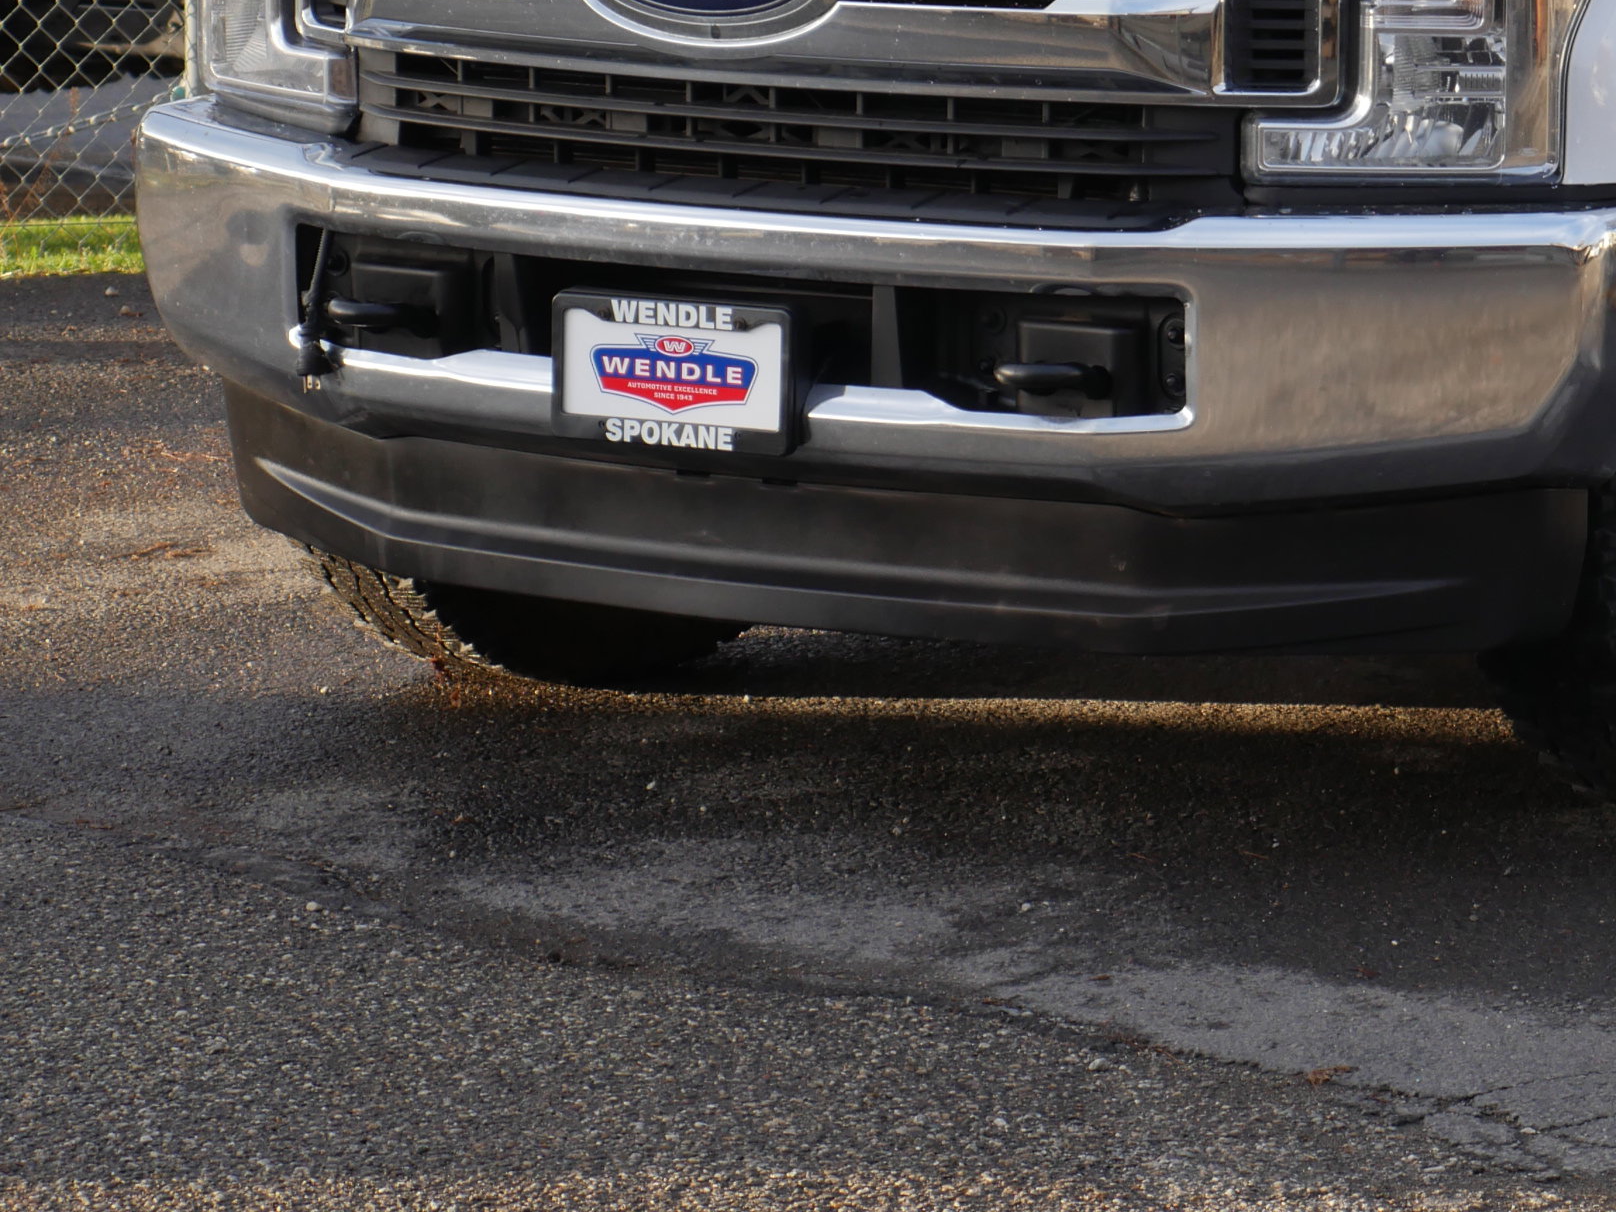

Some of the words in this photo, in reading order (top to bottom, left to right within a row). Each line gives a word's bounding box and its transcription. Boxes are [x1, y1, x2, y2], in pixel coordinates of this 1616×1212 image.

[611, 299, 733, 331] WENDLE
[663, 340, 686, 353] W
[602, 355, 743, 385] WENDLE
[627, 381, 672, 392] AUTOMOTIVE
[673, 385, 718, 396] EXCELLENCE
[653, 391, 675, 400] SINCE
[605, 418, 733, 452] SPOKANE
